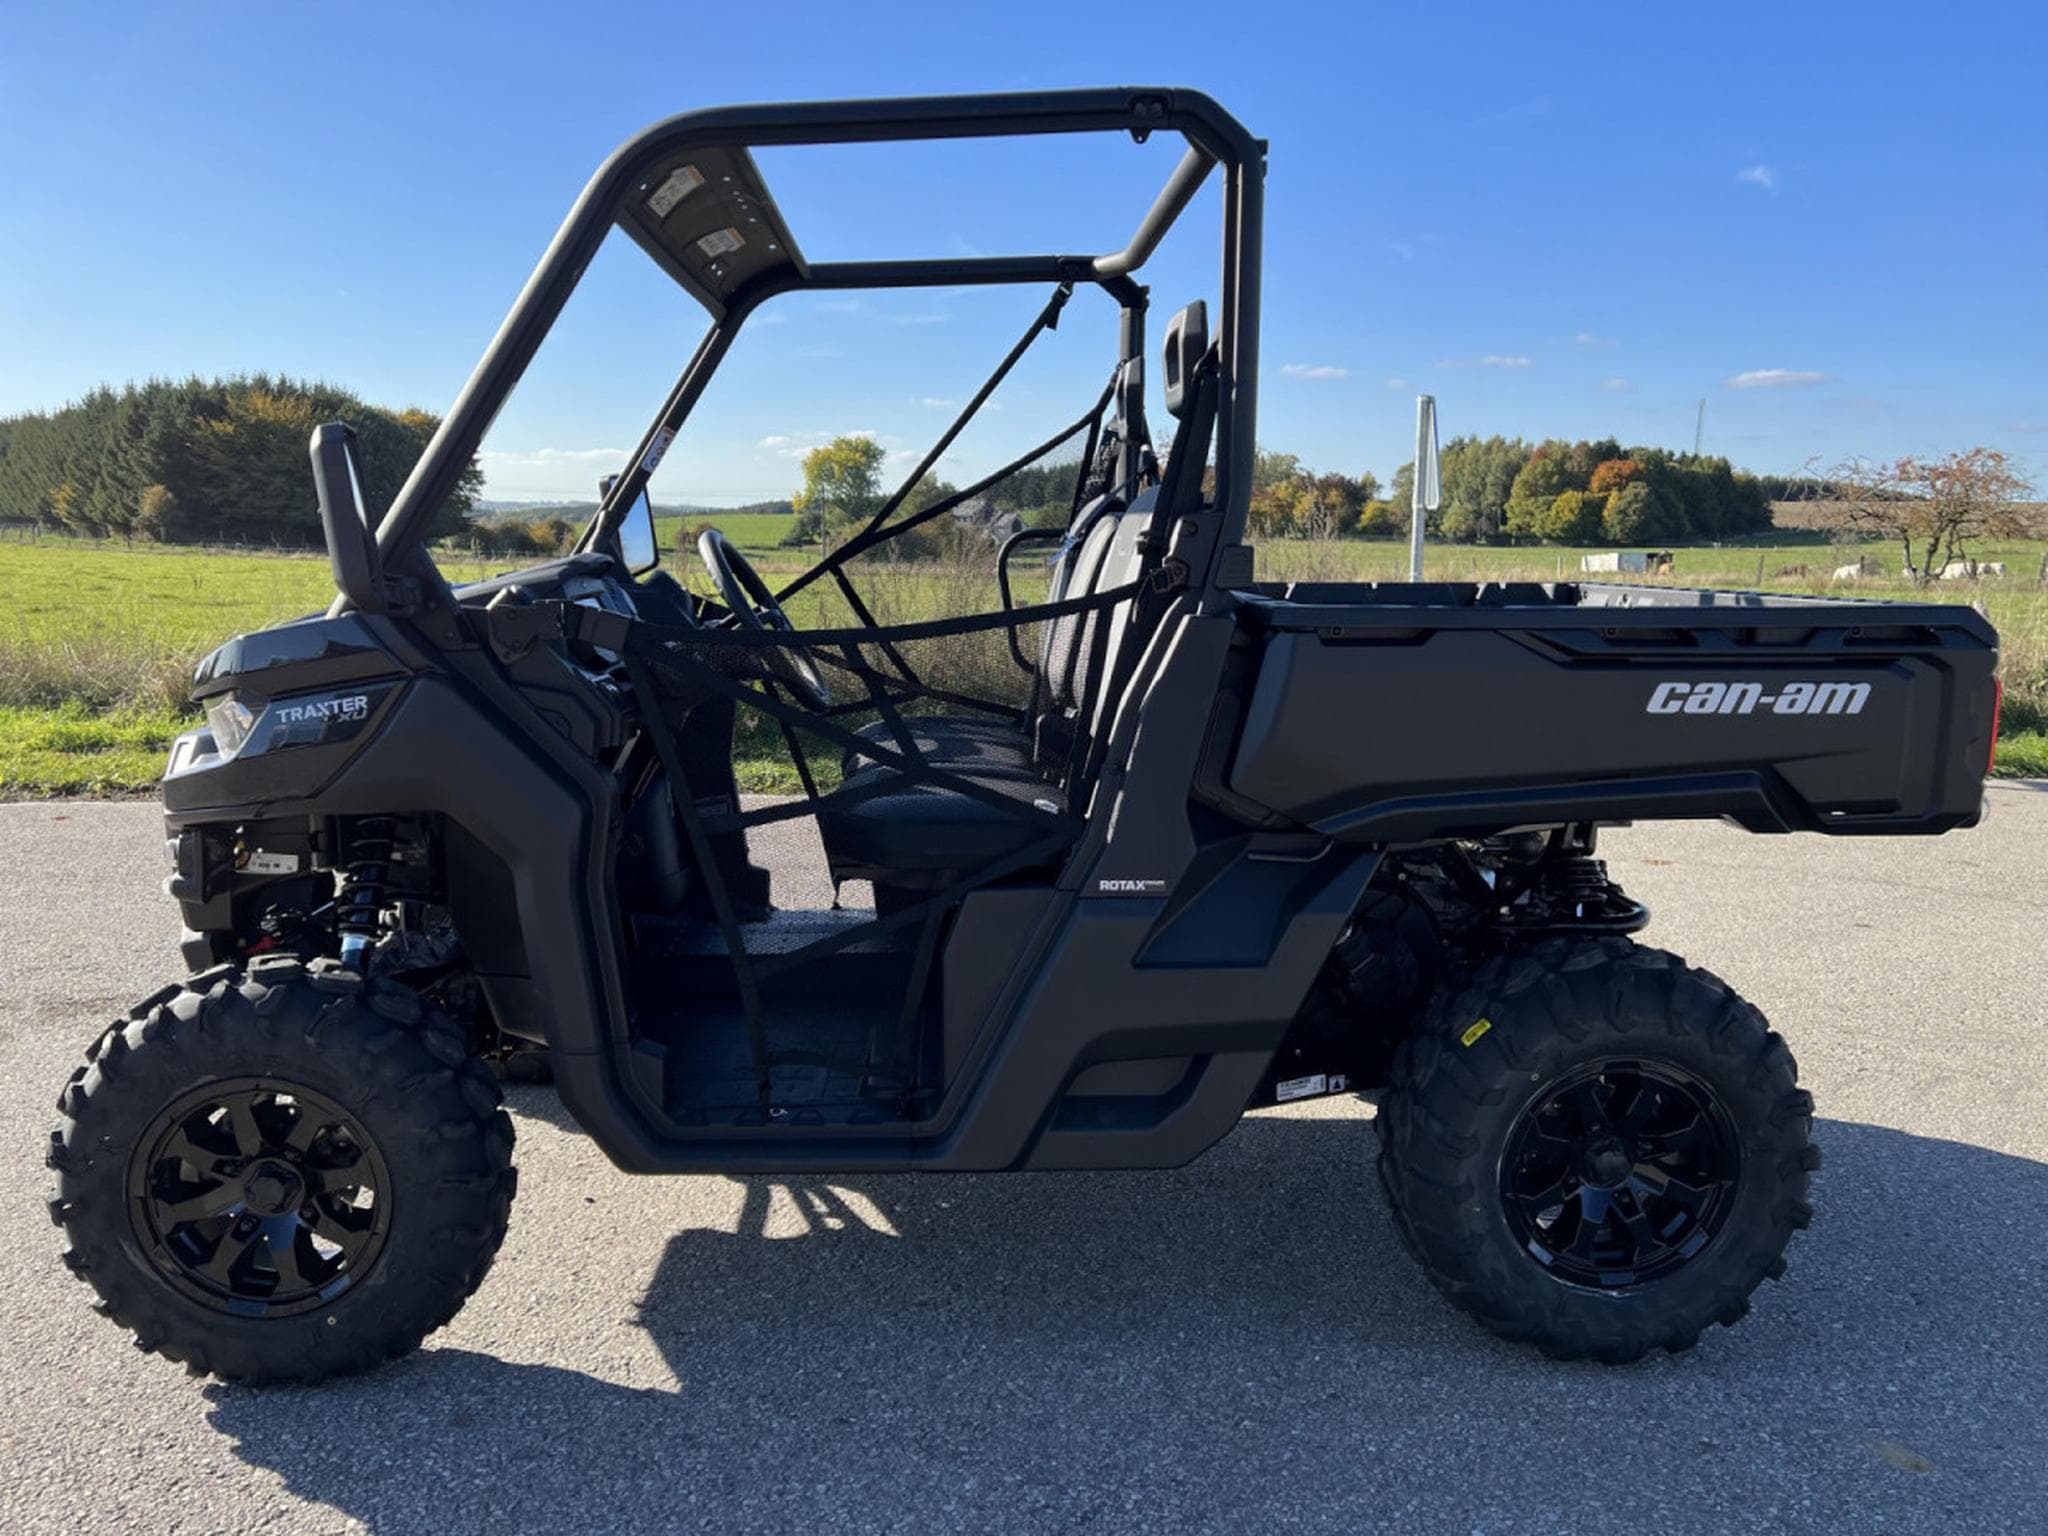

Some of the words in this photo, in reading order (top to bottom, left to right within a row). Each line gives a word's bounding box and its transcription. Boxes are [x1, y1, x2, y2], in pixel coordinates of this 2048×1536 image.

[275, 696, 368, 723] TRAXTER
[1646, 682, 1872, 714] can-am
[1100, 880, 1145, 891] ROTAX
